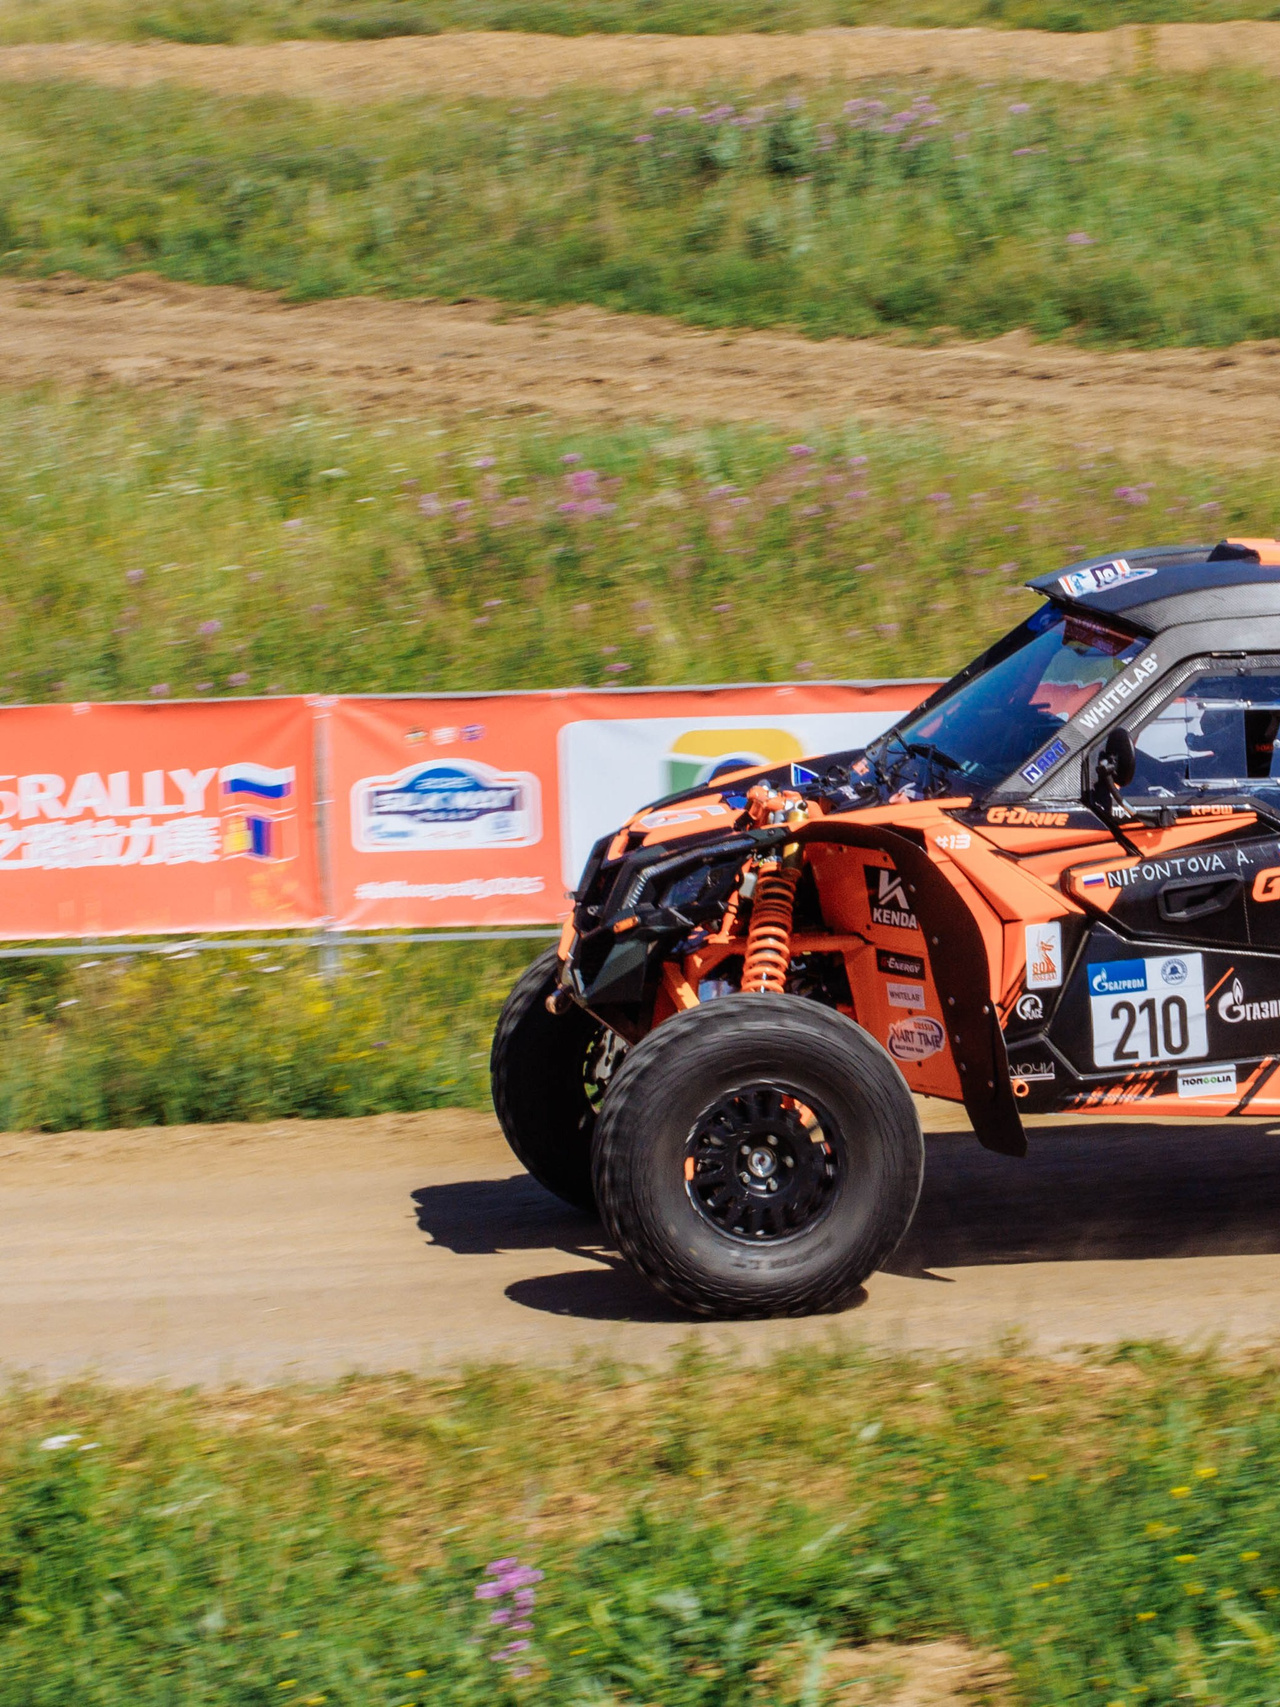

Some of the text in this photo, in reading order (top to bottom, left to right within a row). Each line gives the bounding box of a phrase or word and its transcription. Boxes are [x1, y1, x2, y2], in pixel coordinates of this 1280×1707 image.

[934, 833, 972, 850] #13
[1106, 849, 1255, 889] NIFONTOVA A.
[872, 907, 919, 930] KENDA
[1107, 978, 1146, 991] GAZPROM
[1110, 995, 1190, 1061] 210
